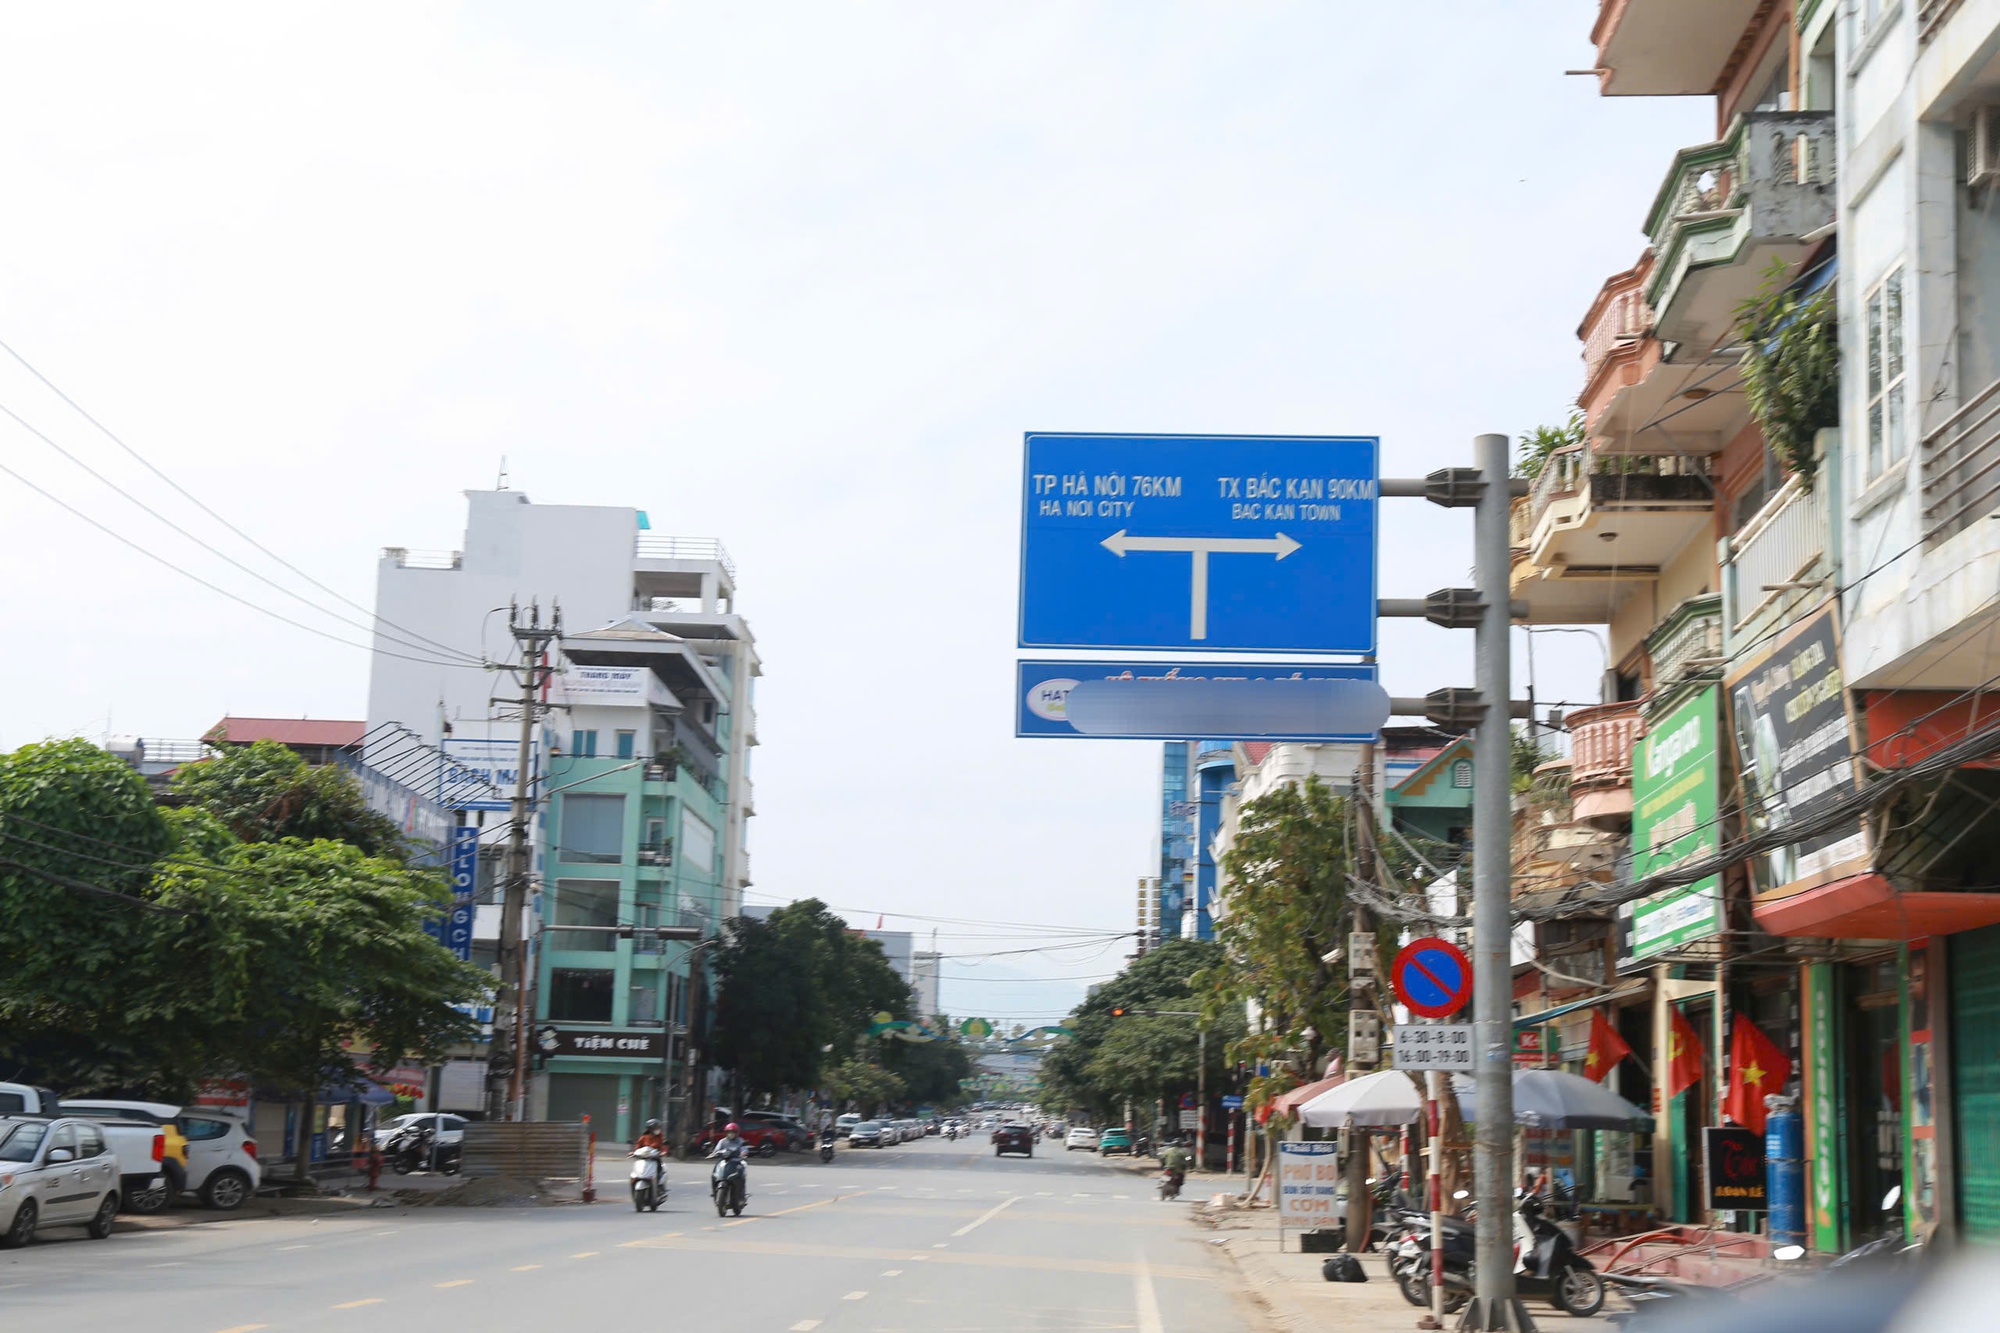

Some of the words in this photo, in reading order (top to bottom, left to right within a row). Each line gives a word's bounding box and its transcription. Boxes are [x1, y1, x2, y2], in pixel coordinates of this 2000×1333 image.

[1032, 474, 1058, 496] TP
[1062, 470, 1090, 496] HÀ
[1094, 471, 1127, 499] NỘI
[1131, 475, 1182, 497] 76KM
[1217, 477, 1241, 499] TX
[1328, 478, 1374, 500] 90KM
[1039, 500, 1062, 517] HA
[1066, 500, 1094, 517] NOI
[1097, 501, 1136, 518] CITY
[1231, 503, 1262, 520] BAC
[1264, 503, 1296, 521] KAN
[1299, 504, 1342, 521] TOWN
